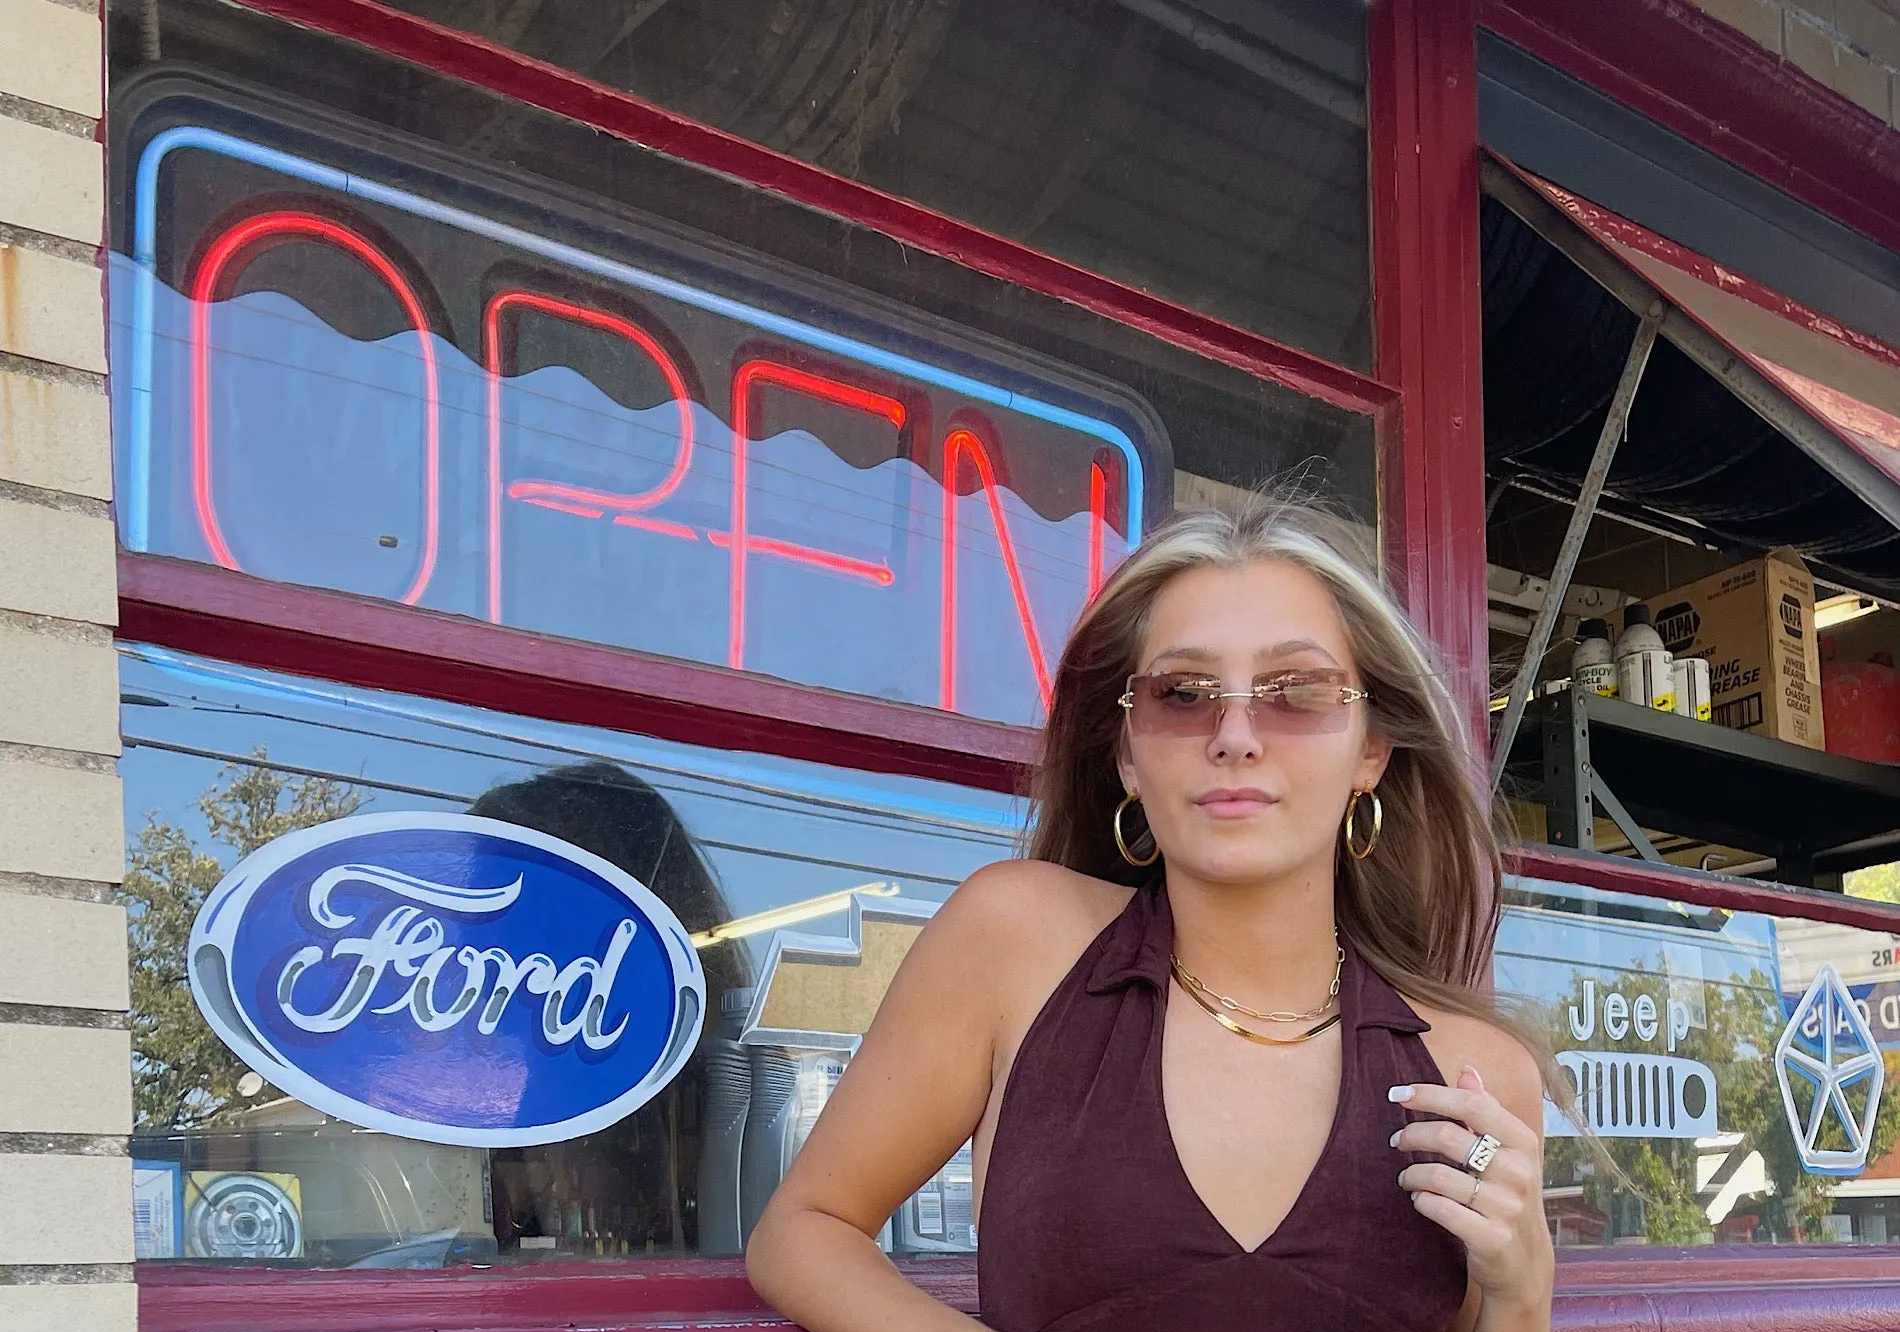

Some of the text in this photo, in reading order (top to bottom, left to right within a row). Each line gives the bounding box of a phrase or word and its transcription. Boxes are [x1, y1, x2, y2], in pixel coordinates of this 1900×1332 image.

[190, 211, 1106, 725] OPEN
[1658, 611, 1695, 645] NAPA
[1785, 687, 1810, 705] CHASSIS
[1791, 679, 1804, 691] AND
[1786, 698, 1811, 715] GREASE
[278, 862, 640, 1051] Ford
[1568, 980, 1689, 1052] Jeep
